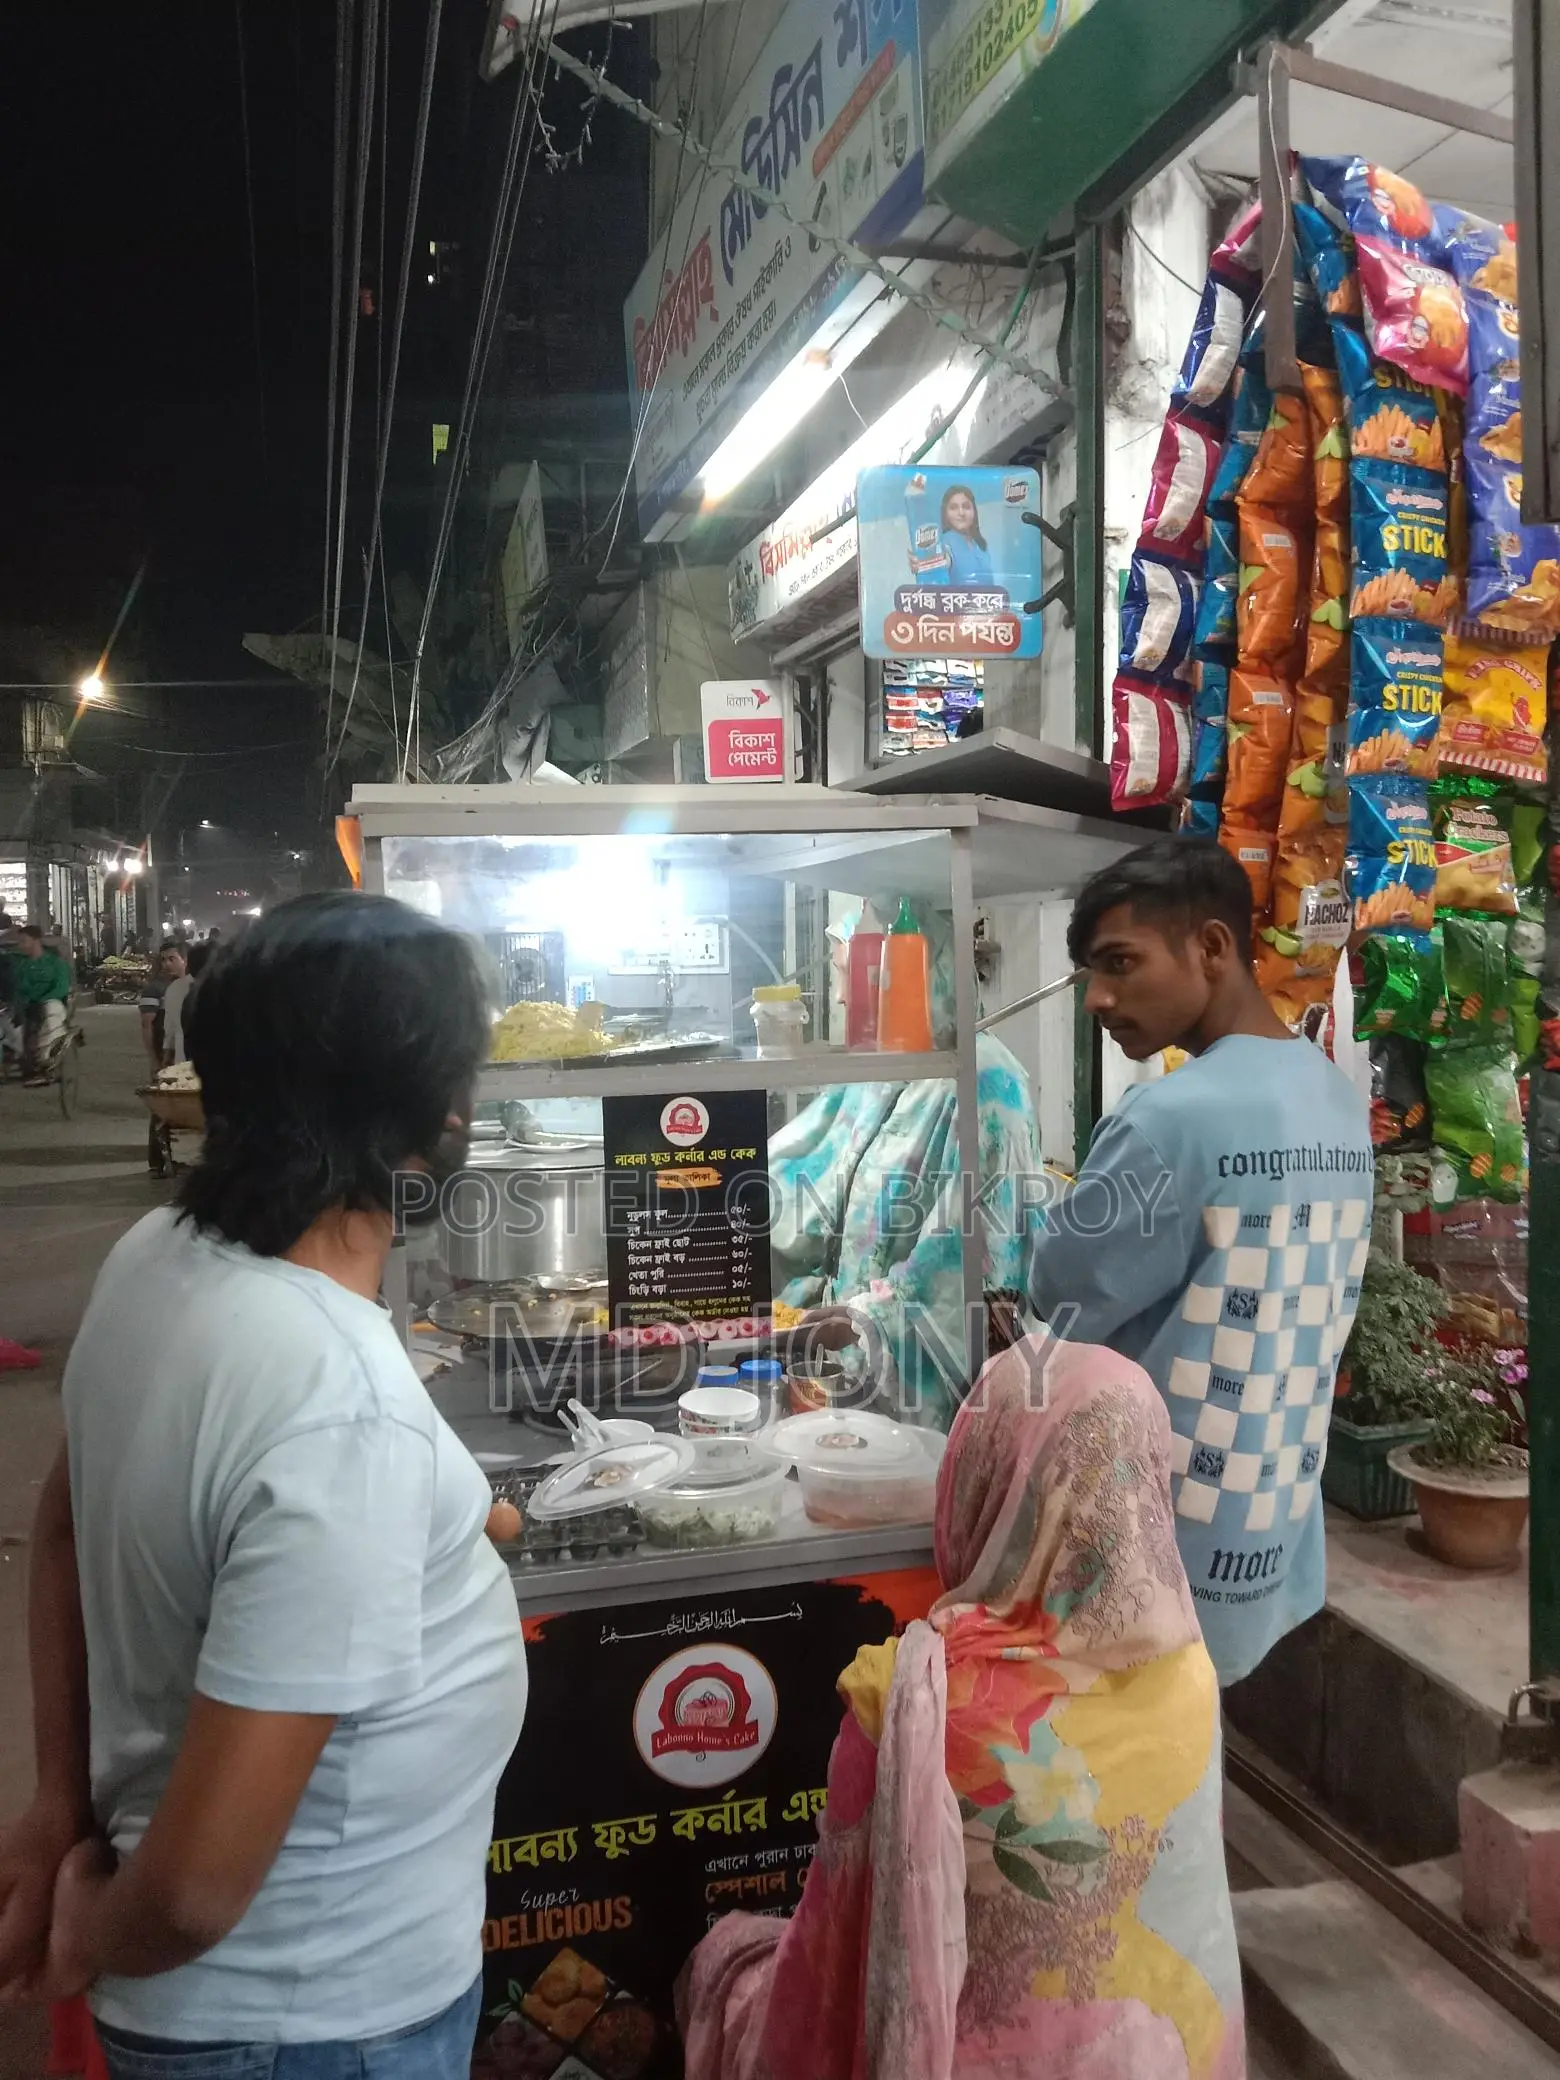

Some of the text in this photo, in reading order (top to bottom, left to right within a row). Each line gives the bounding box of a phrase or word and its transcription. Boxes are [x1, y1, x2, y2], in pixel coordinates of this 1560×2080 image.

[785, 235, 792, 260] ও
[900, 590, 1003, 614] দুর্গন্ধ ব্লক করে
[891, 613, 1015, 646] ৩ দিন পর্যন্ত
[729, 729, 776, 749] বিকাশ
[728, 748, 778, 767] পেমেন্ট
[1449, 806, 1499, 827] Potato
[615, 1152, 647, 1167] লাবন্য
[674, 1147, 705, 1163] কর্নার
[731, 1147, 756, 1160] কেক
[627, 1238, 652, 1251] চিকেন
[628, 1254, 652, 1266] চিকেন
[1212, 1374, 1245, 1397] more
[1208, 1543, 1284, 1583] more
[656, 1729, 694, 1750] Labonno
[733, 1730, 756, 1746] Cake
[591, 1813, 658, 1861] ফুড
[669, 1788, 768, 1841] কর্নার
[704, 1853, 750, 1873] এখানে
[754, 1848, 788, 1869] পুরান
[704, 1870, 788, 1905] স্পেশাল
[520, 1887, 580, 1916] Super
[481, 1894, 634, 1953] DELICIOUS
